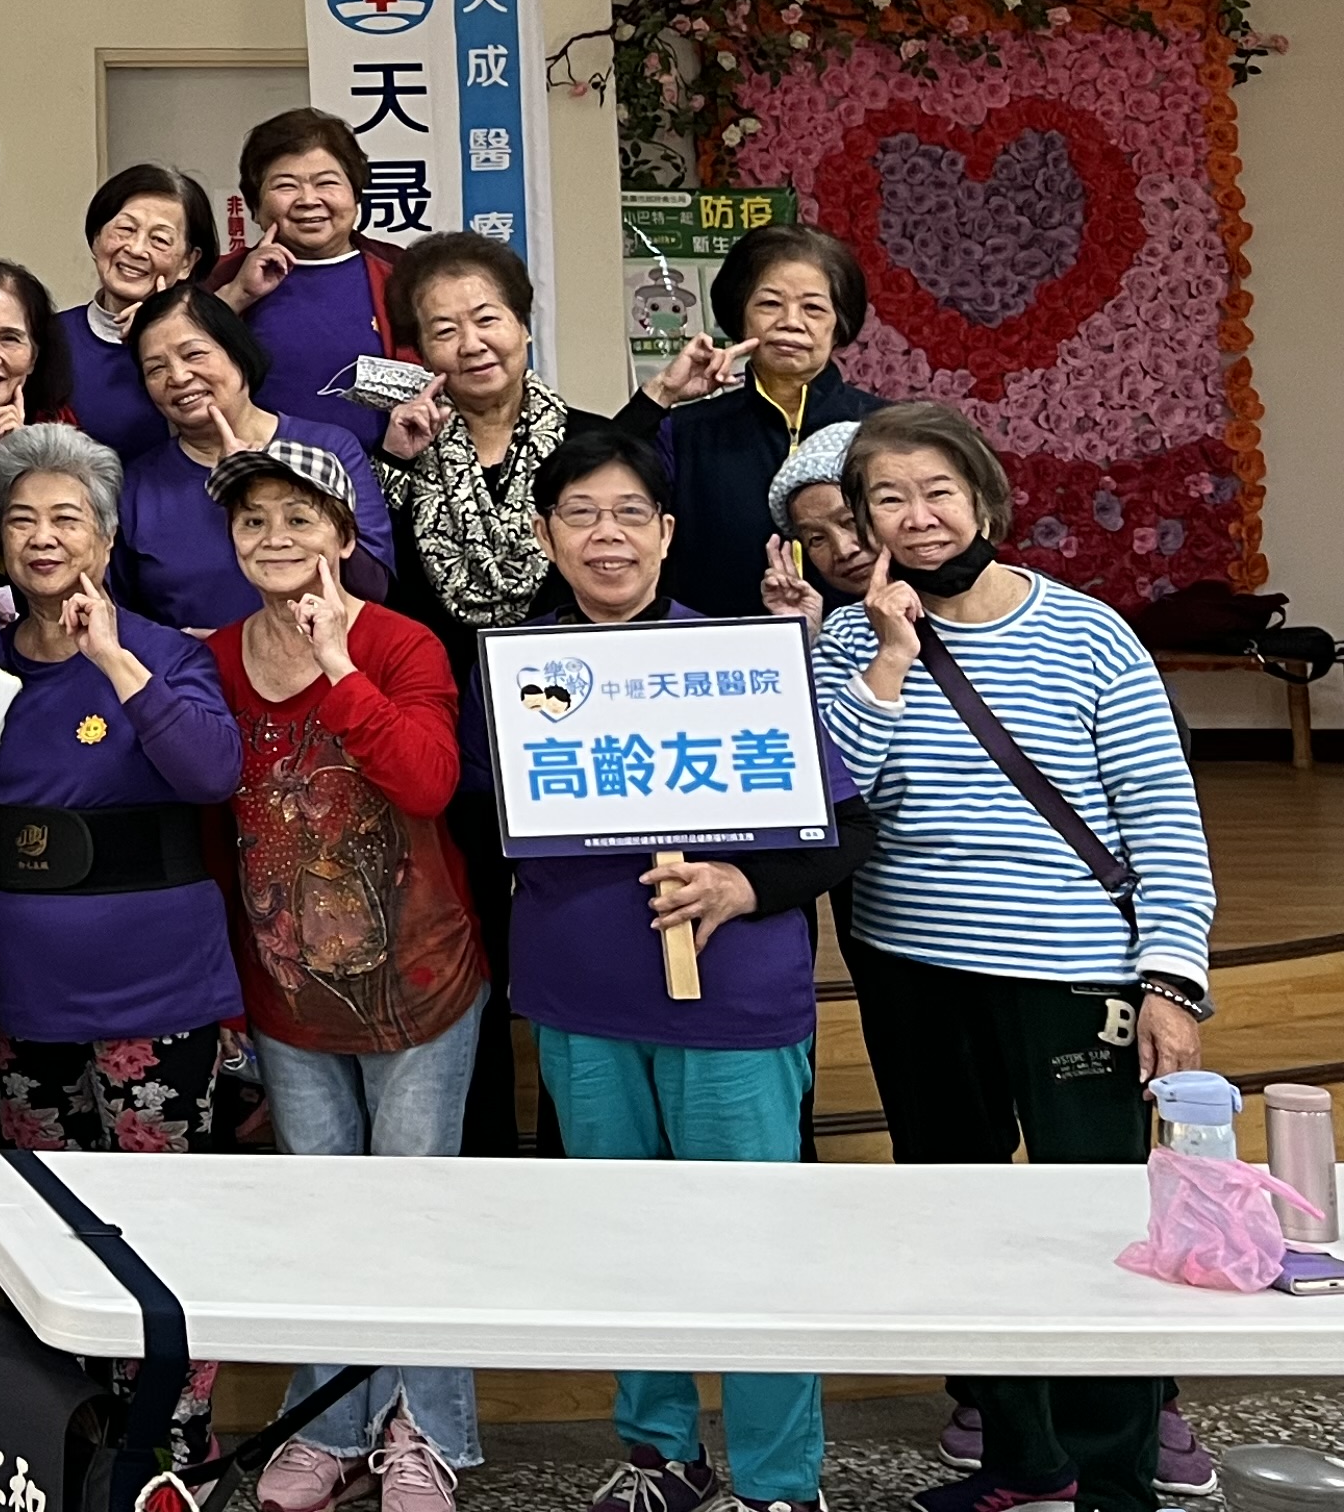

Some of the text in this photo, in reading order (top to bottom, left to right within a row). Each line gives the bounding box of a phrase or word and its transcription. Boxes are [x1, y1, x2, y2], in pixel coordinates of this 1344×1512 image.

[350, 61, 433, 234] 天晟
[700, 195, 773, 229] 防疫
[692, 236, 739, 254] 新生
[600, 669, 782, 701] 中壢天晟醫院
[522, 728, 797, 802] 高齡友善
[1097, 998, 1137, 1047] B
